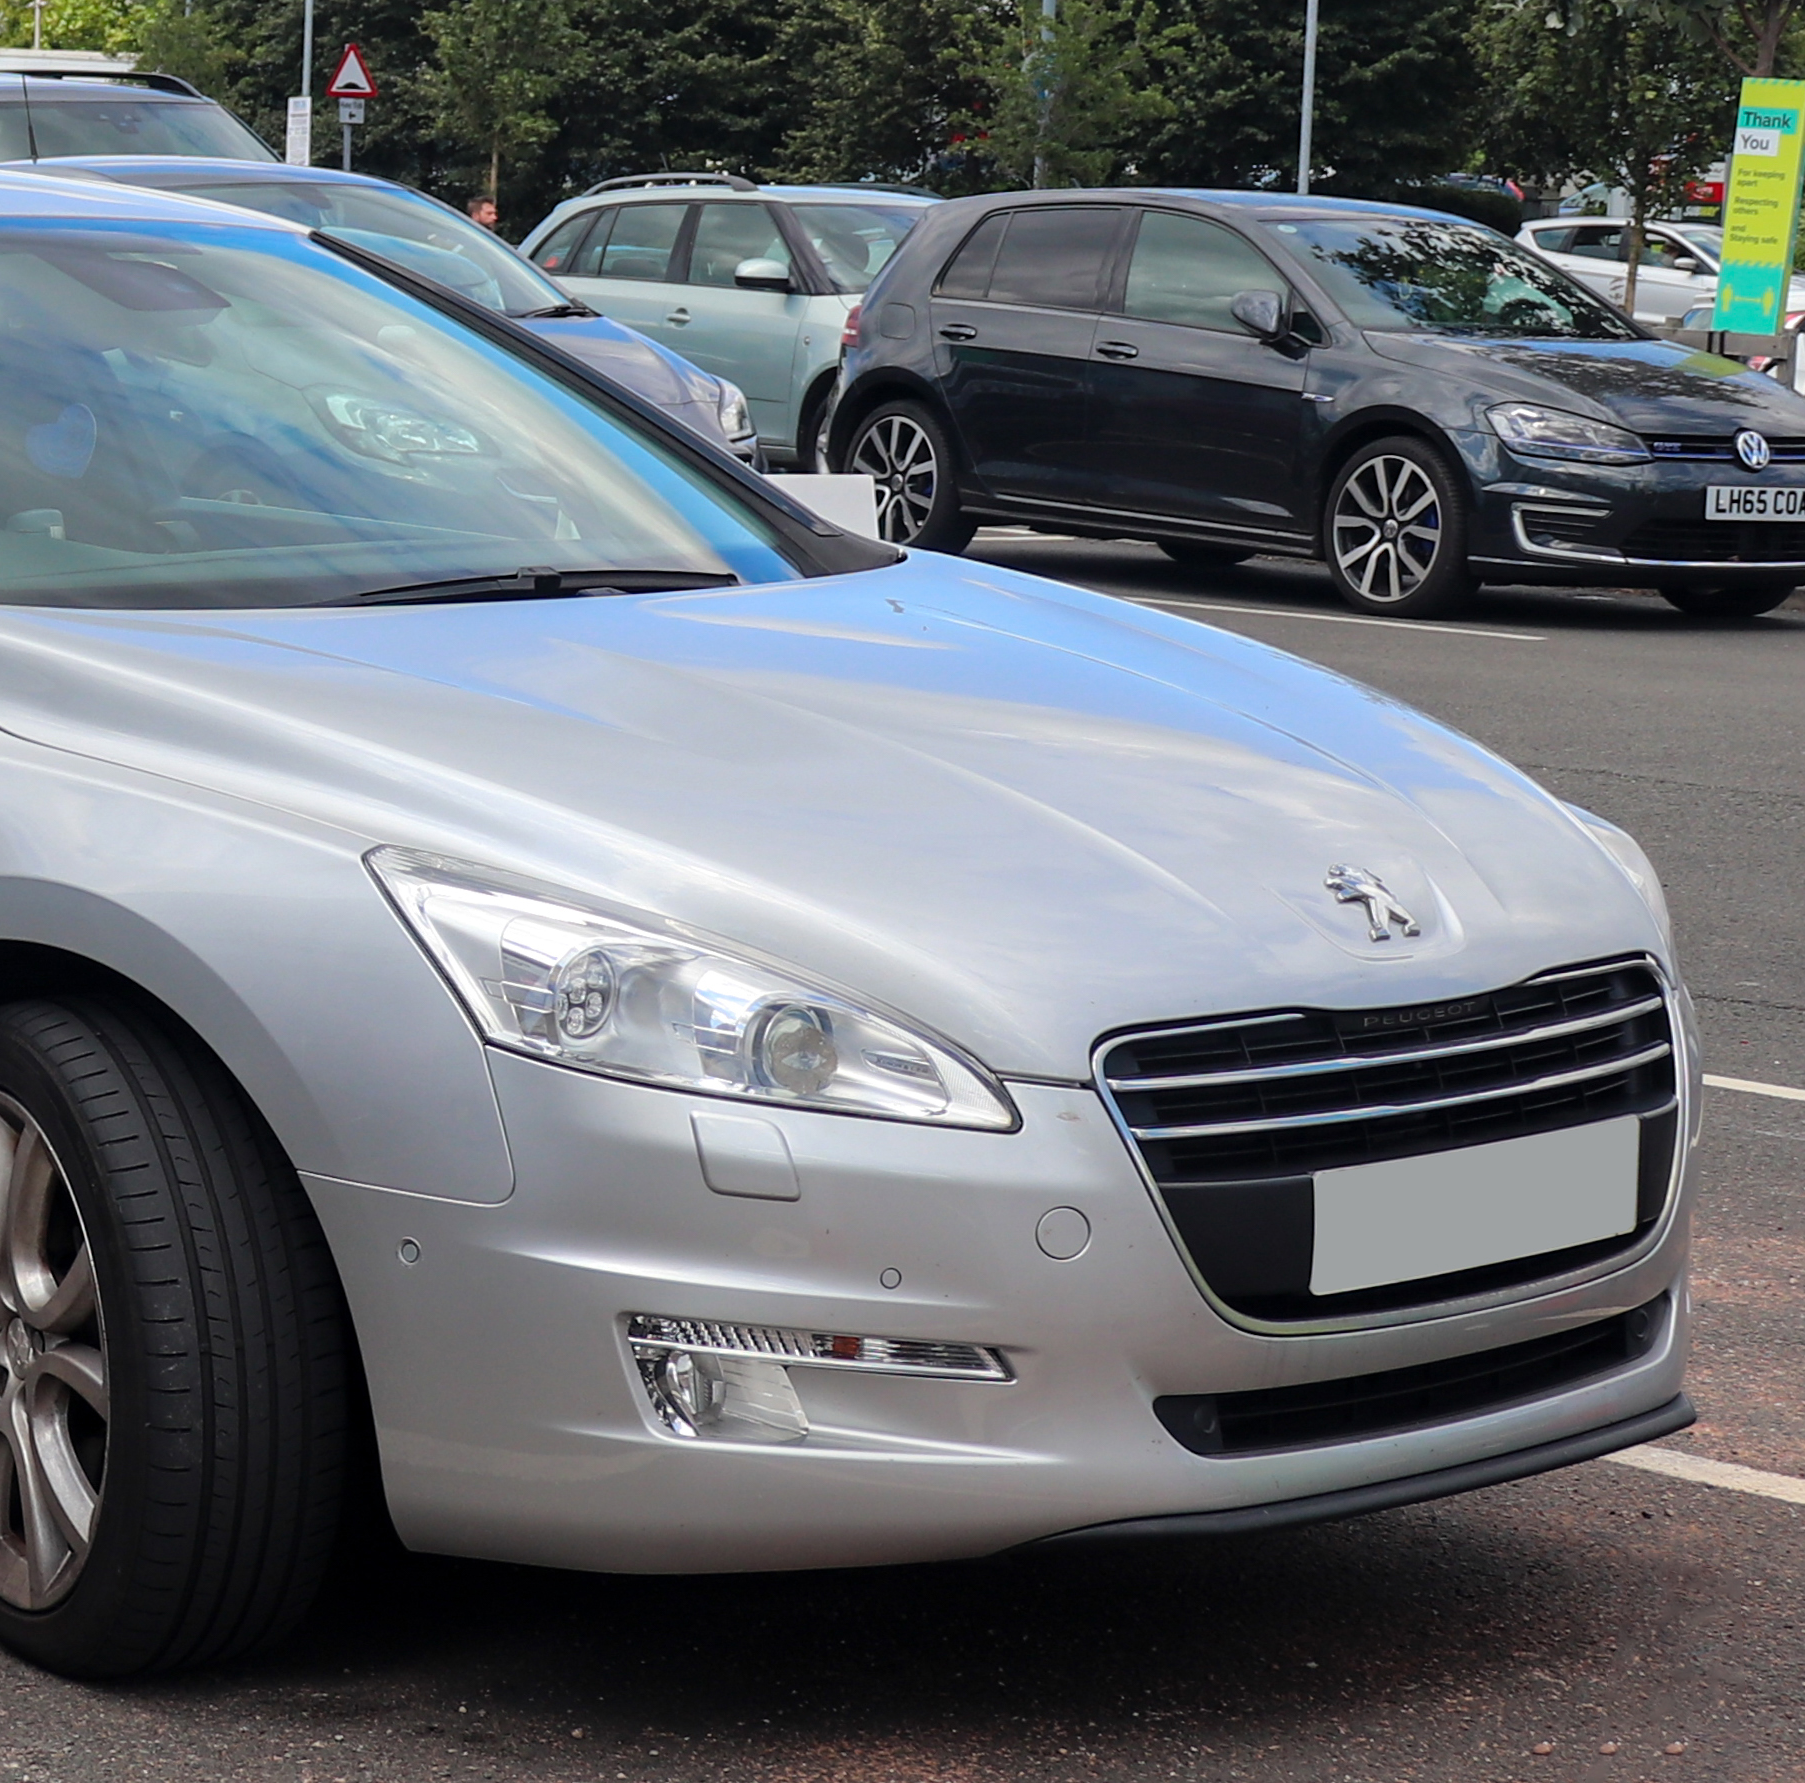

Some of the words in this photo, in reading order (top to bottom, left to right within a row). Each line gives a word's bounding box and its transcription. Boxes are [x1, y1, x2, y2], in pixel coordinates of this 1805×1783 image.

[1743, 111, 1792, 129] Thank
[1741, 134, 1770, 150] You
[1737, 168, 1752, 177] For
[1753, 170, 1786, 181] keeping
[1734, 196, 1779, 209] Respecting
[1729, 234, 1759, 245] Staying
[1761, 236, 1778, 244] safe
[1715, 489, 1766, 514] LH65
[1363, 1001, 1475, 1028] PEUGEOT
